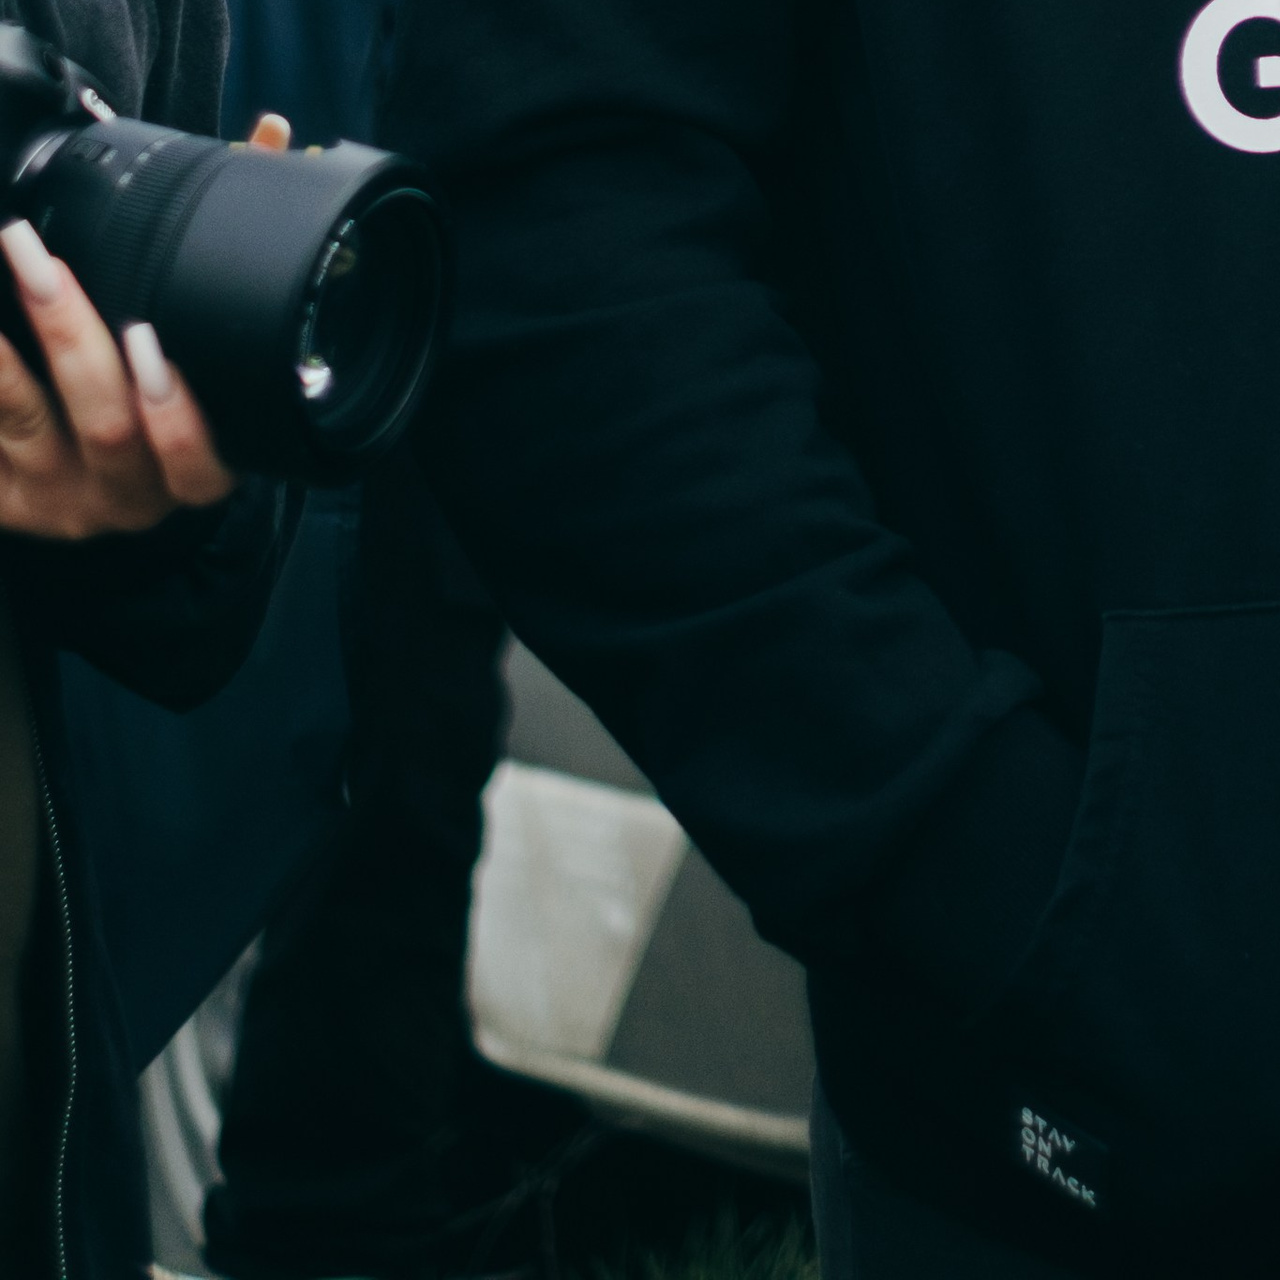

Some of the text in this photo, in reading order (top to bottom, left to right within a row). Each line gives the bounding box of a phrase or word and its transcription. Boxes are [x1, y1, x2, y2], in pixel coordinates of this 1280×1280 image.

[1021, 1106, 1076, 1153] STAY
[1021, 1126, 1052, 1158] ON
[1022, 1143, 1097, 1207] TRACK
